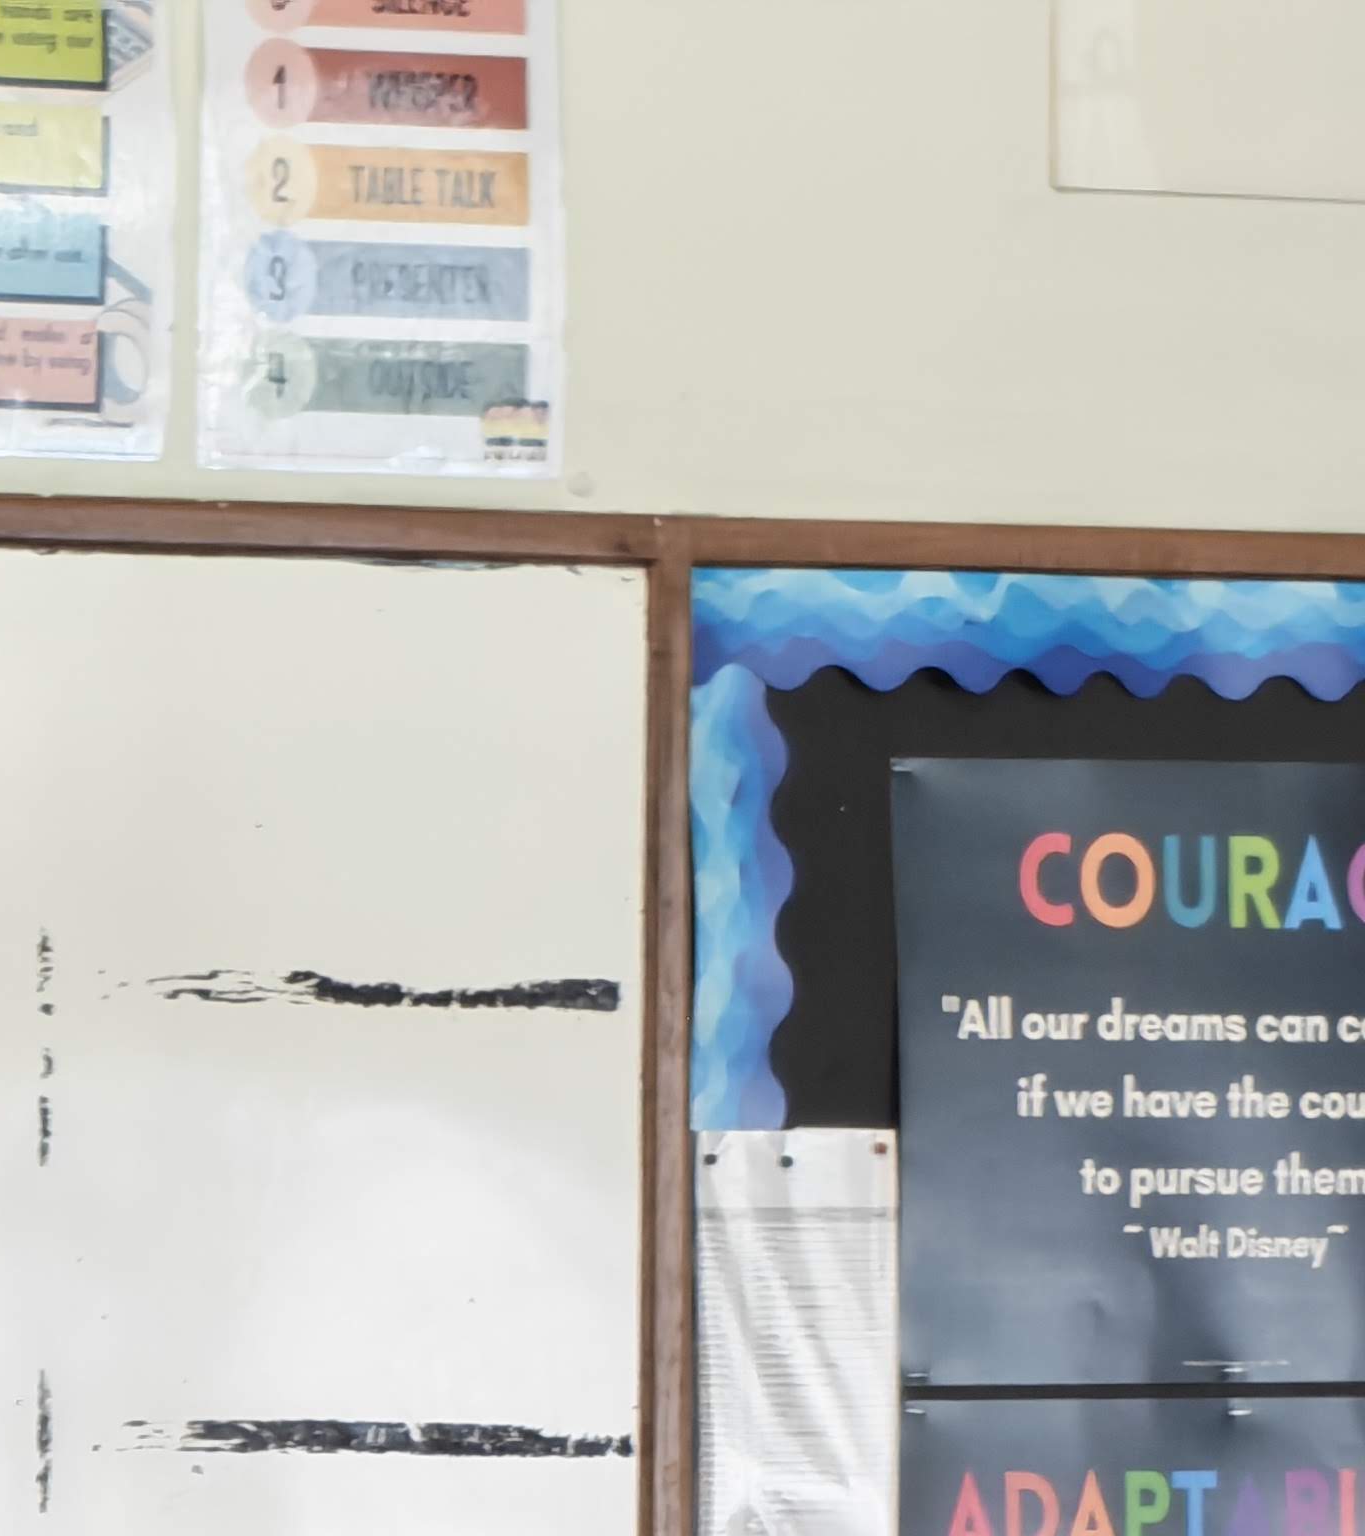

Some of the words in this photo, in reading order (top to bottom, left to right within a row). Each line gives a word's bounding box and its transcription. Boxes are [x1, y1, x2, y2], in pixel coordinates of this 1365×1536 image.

[272, 64, 288, 110] 1
[271, 156, 291, 203] 2
[348, 163, 424, 206] TABLE
[433, 168, 497, 209] TALK
[269, 254, 288, 302] 3
[1019, 831, 1365, 930] COURA
[1021, 1012, 1089, 1041] our
[1097, 996, 1248, 1043] dreams
[1255, 1013, 1330, 1044] can
[1016, 1072, 1049, 1119] if
[1053, 1090, 1114, 1119] we
[1122, 1073, 1218, 1119] have
[1226, 1074, 1291, 1119] the
[1079, 1157, 1122, 1196] to
[1129, 1166, 1265, 1209] pursue
[1272, 1151, 1365, 1196] them
